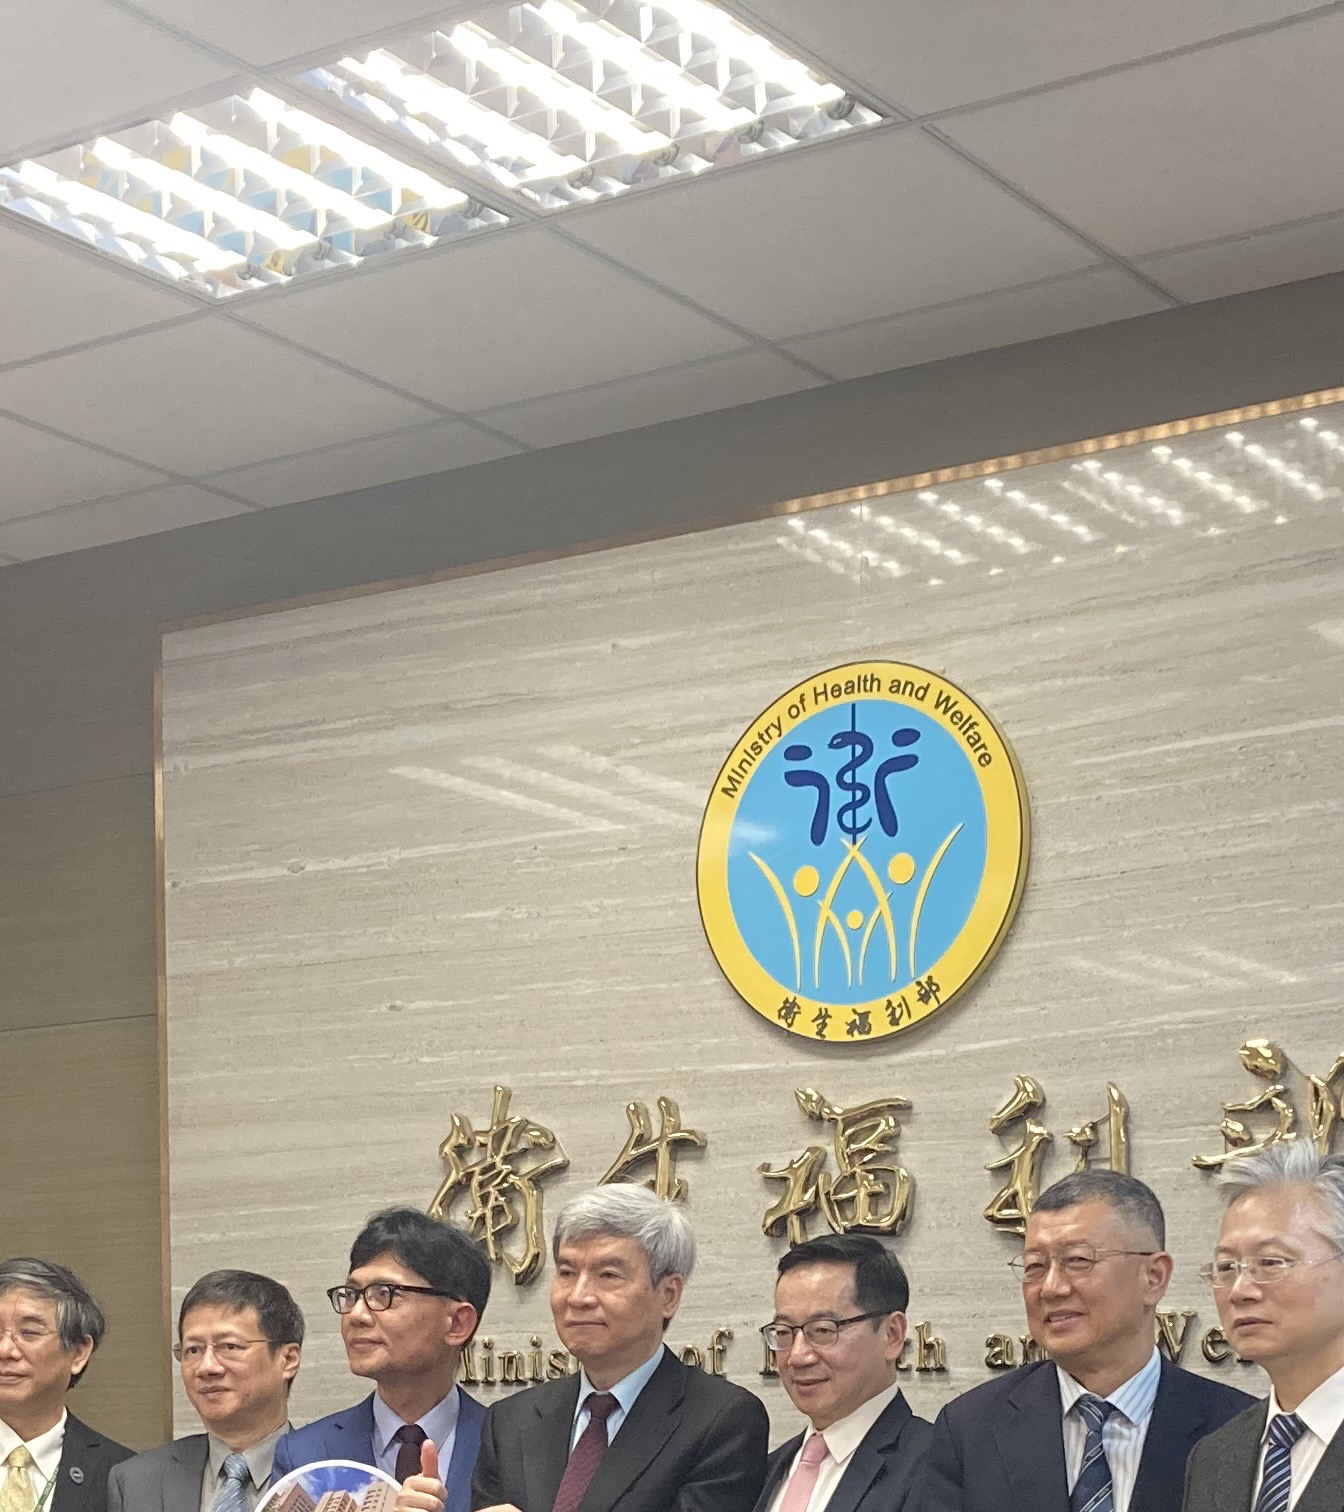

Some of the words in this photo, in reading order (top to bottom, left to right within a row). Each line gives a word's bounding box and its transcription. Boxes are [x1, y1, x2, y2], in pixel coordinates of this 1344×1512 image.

[720, 717, 783, 800] Ministry
[786, 693, 807, 721] of
[813, 673, 882, 703] Health
[888, 678, 931, 702] and
[933, 690, 993, 769] Welfare
